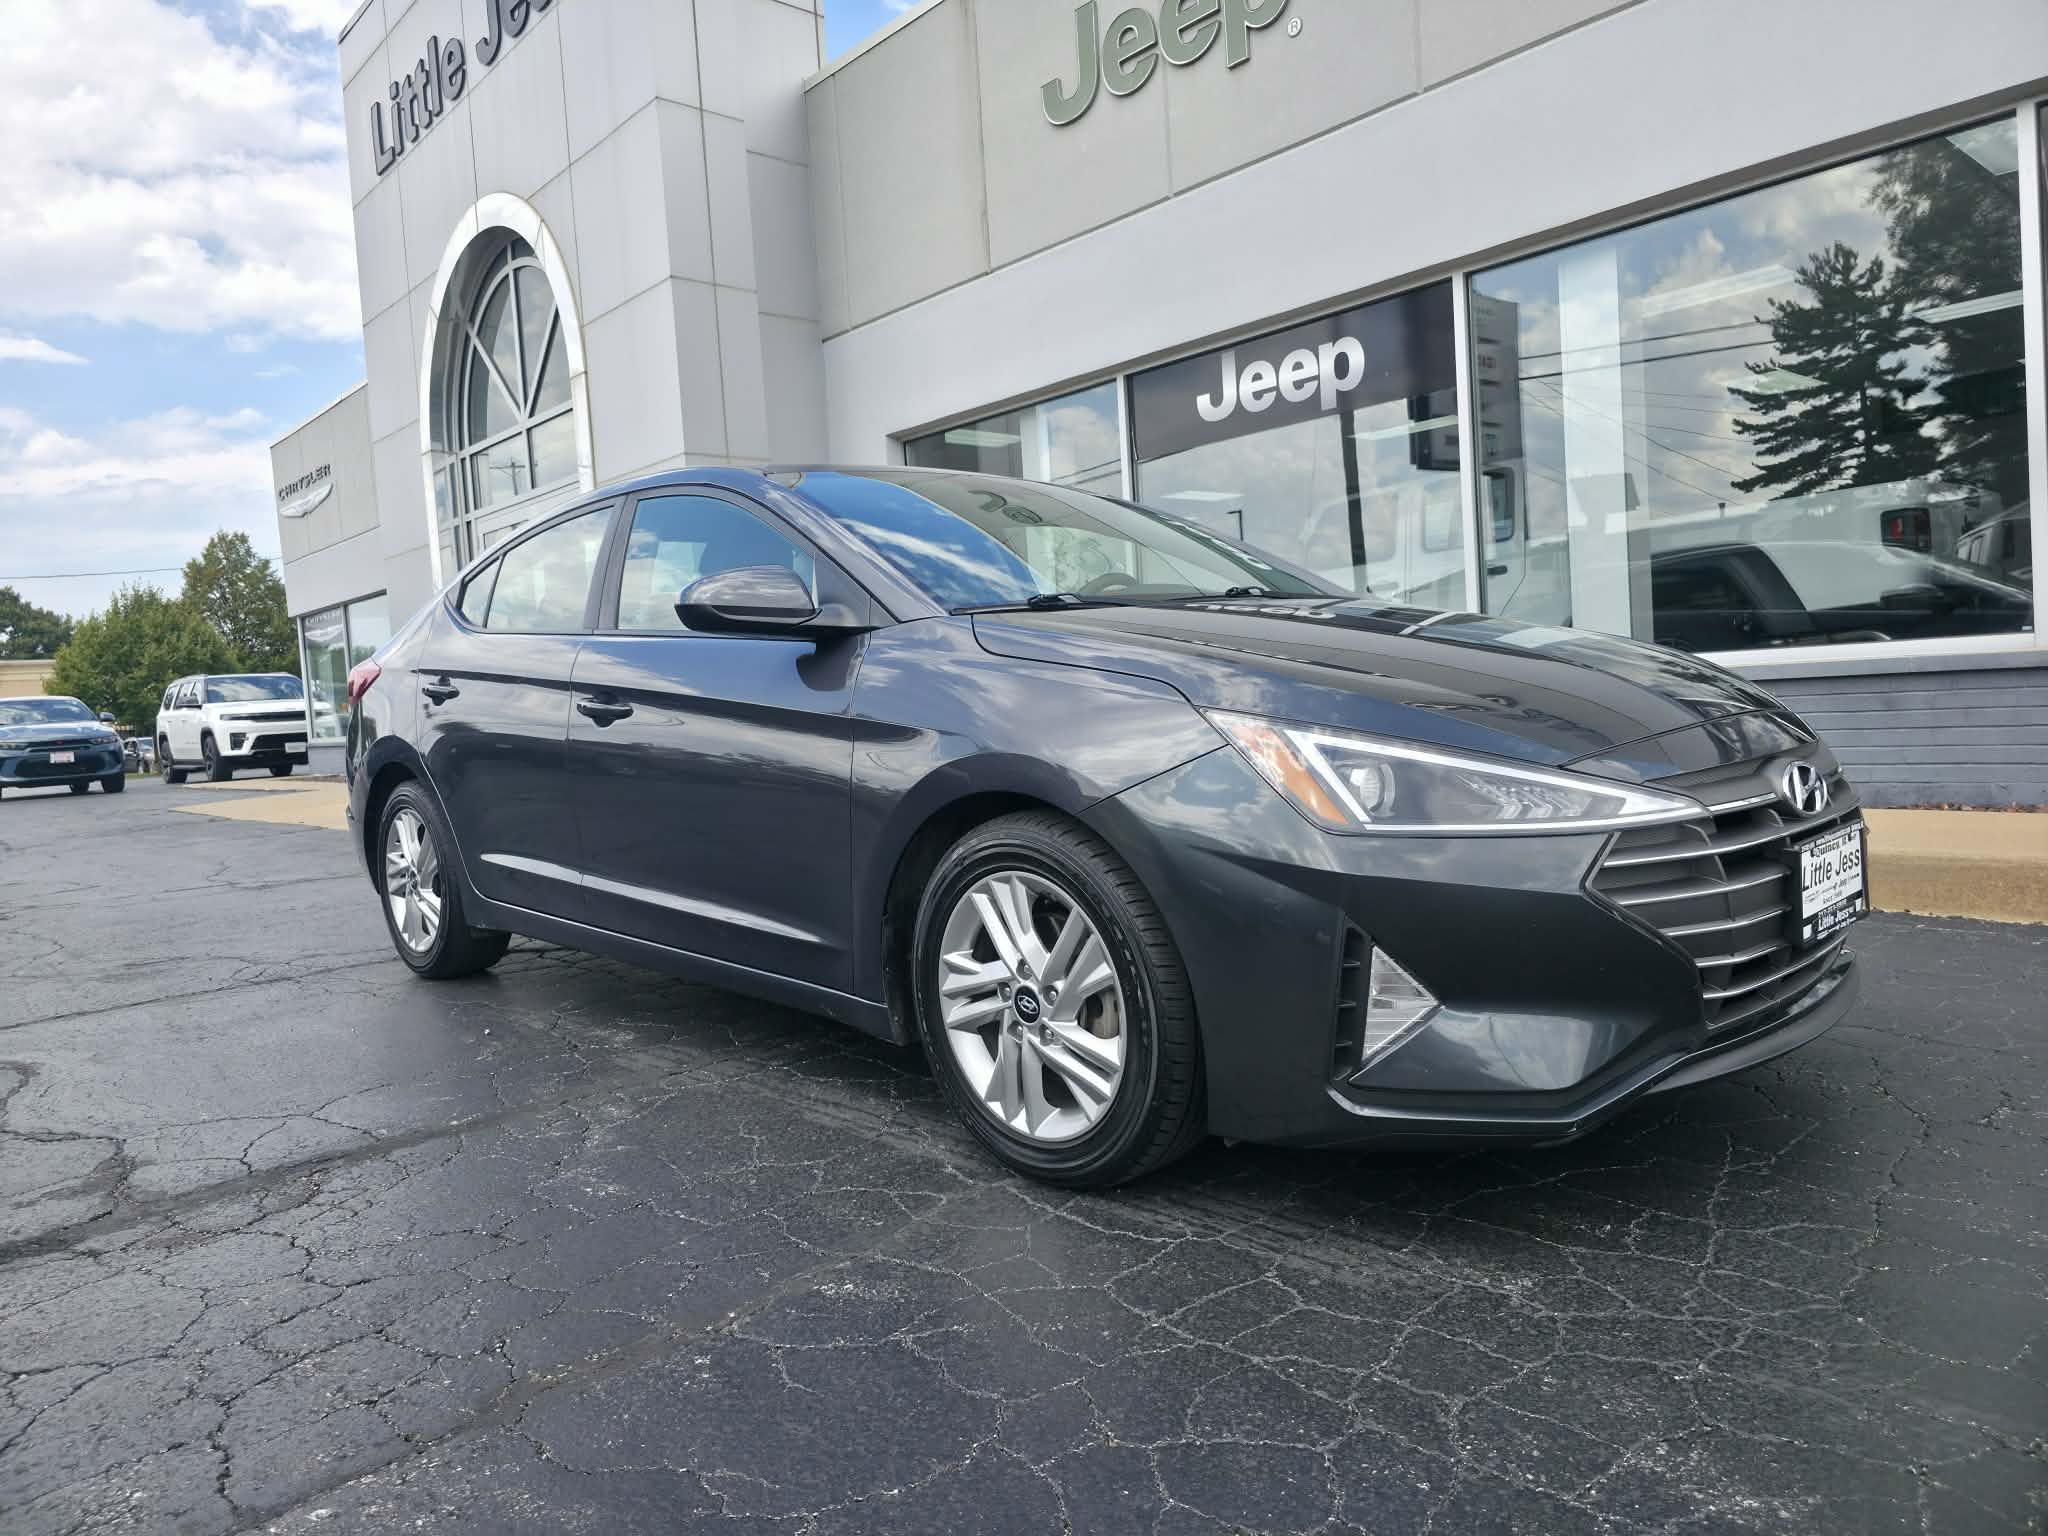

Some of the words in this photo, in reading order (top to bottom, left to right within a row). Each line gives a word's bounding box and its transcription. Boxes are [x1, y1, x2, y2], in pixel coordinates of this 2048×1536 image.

[371, 35, 466, 176] Little
[476, 0, 552, 66] Je
[1040, 0, 1289, 126] Jeep
[1196, 336, 1366, 423] Jeep
[279, 463, 332, 502] CHRYSLER
[1801, 857, 1832, 891] Little
[1835, 848, 1860, 876] Jess
